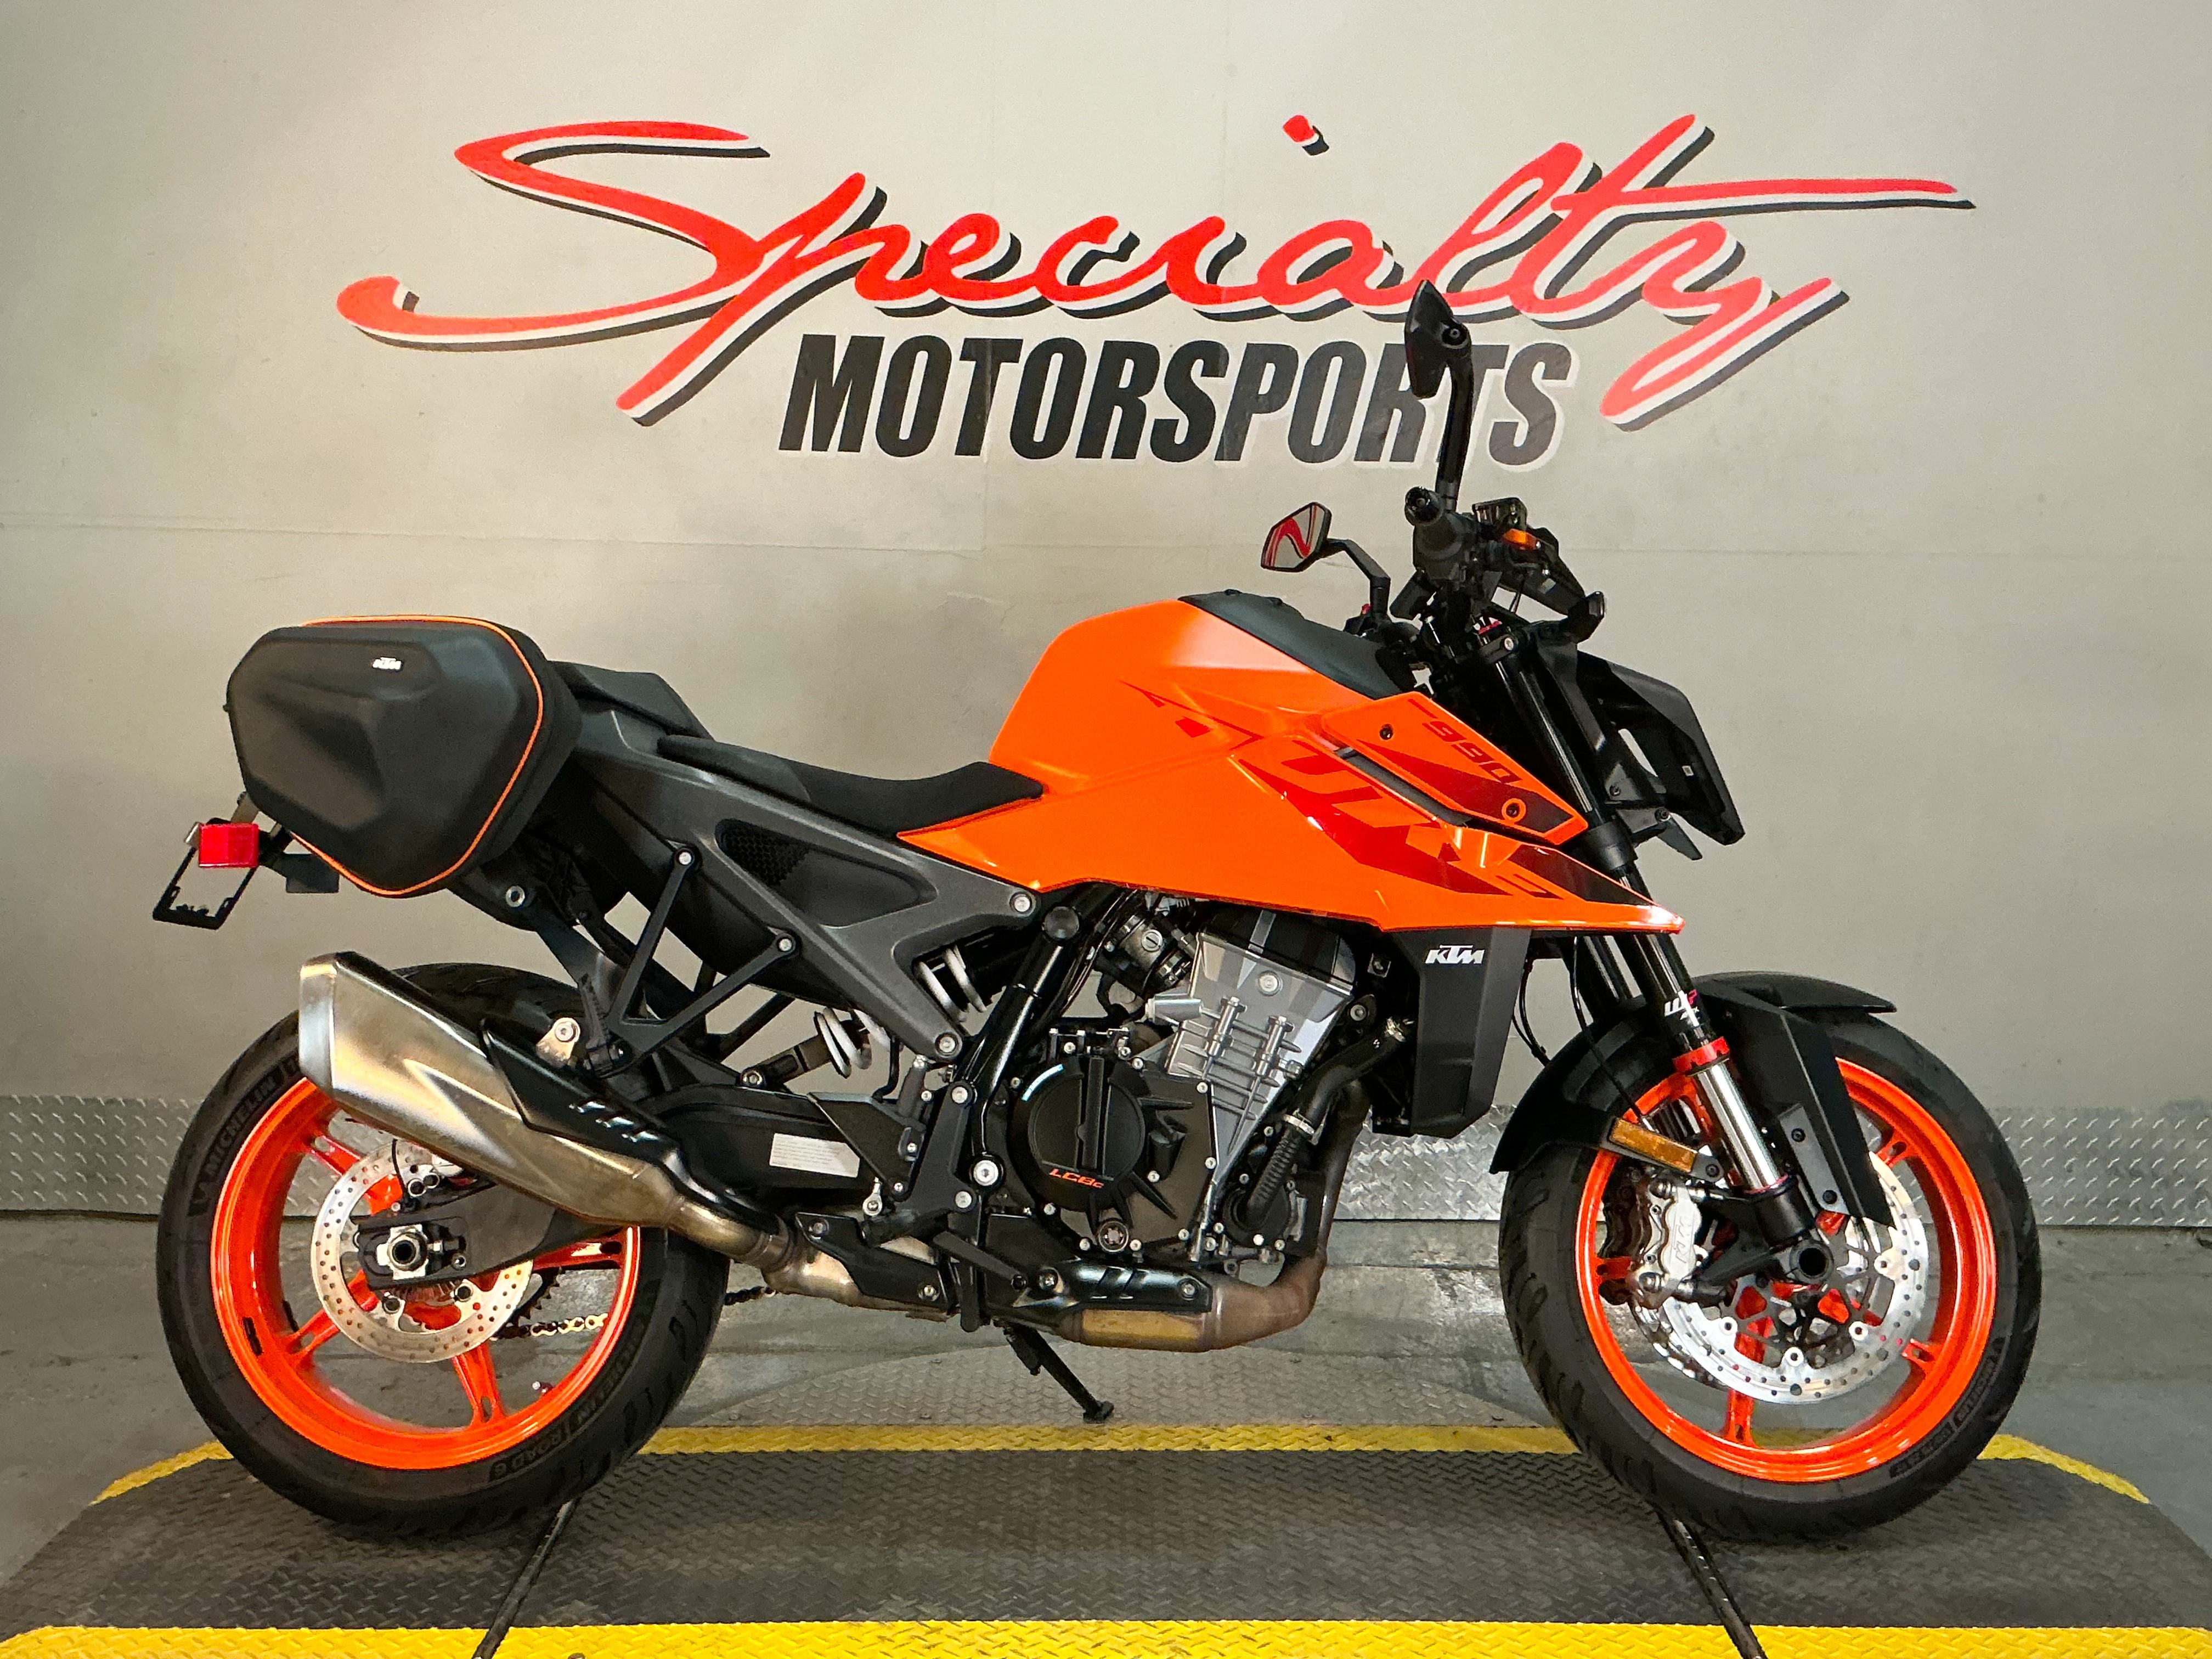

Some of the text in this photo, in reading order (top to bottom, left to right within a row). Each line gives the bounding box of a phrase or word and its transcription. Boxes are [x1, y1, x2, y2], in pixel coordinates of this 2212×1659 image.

[336, 113, 1977, 431] Specialty
[1422, 721, 1523, 785] 990
[1425, 944, 1485, 965] KTM
